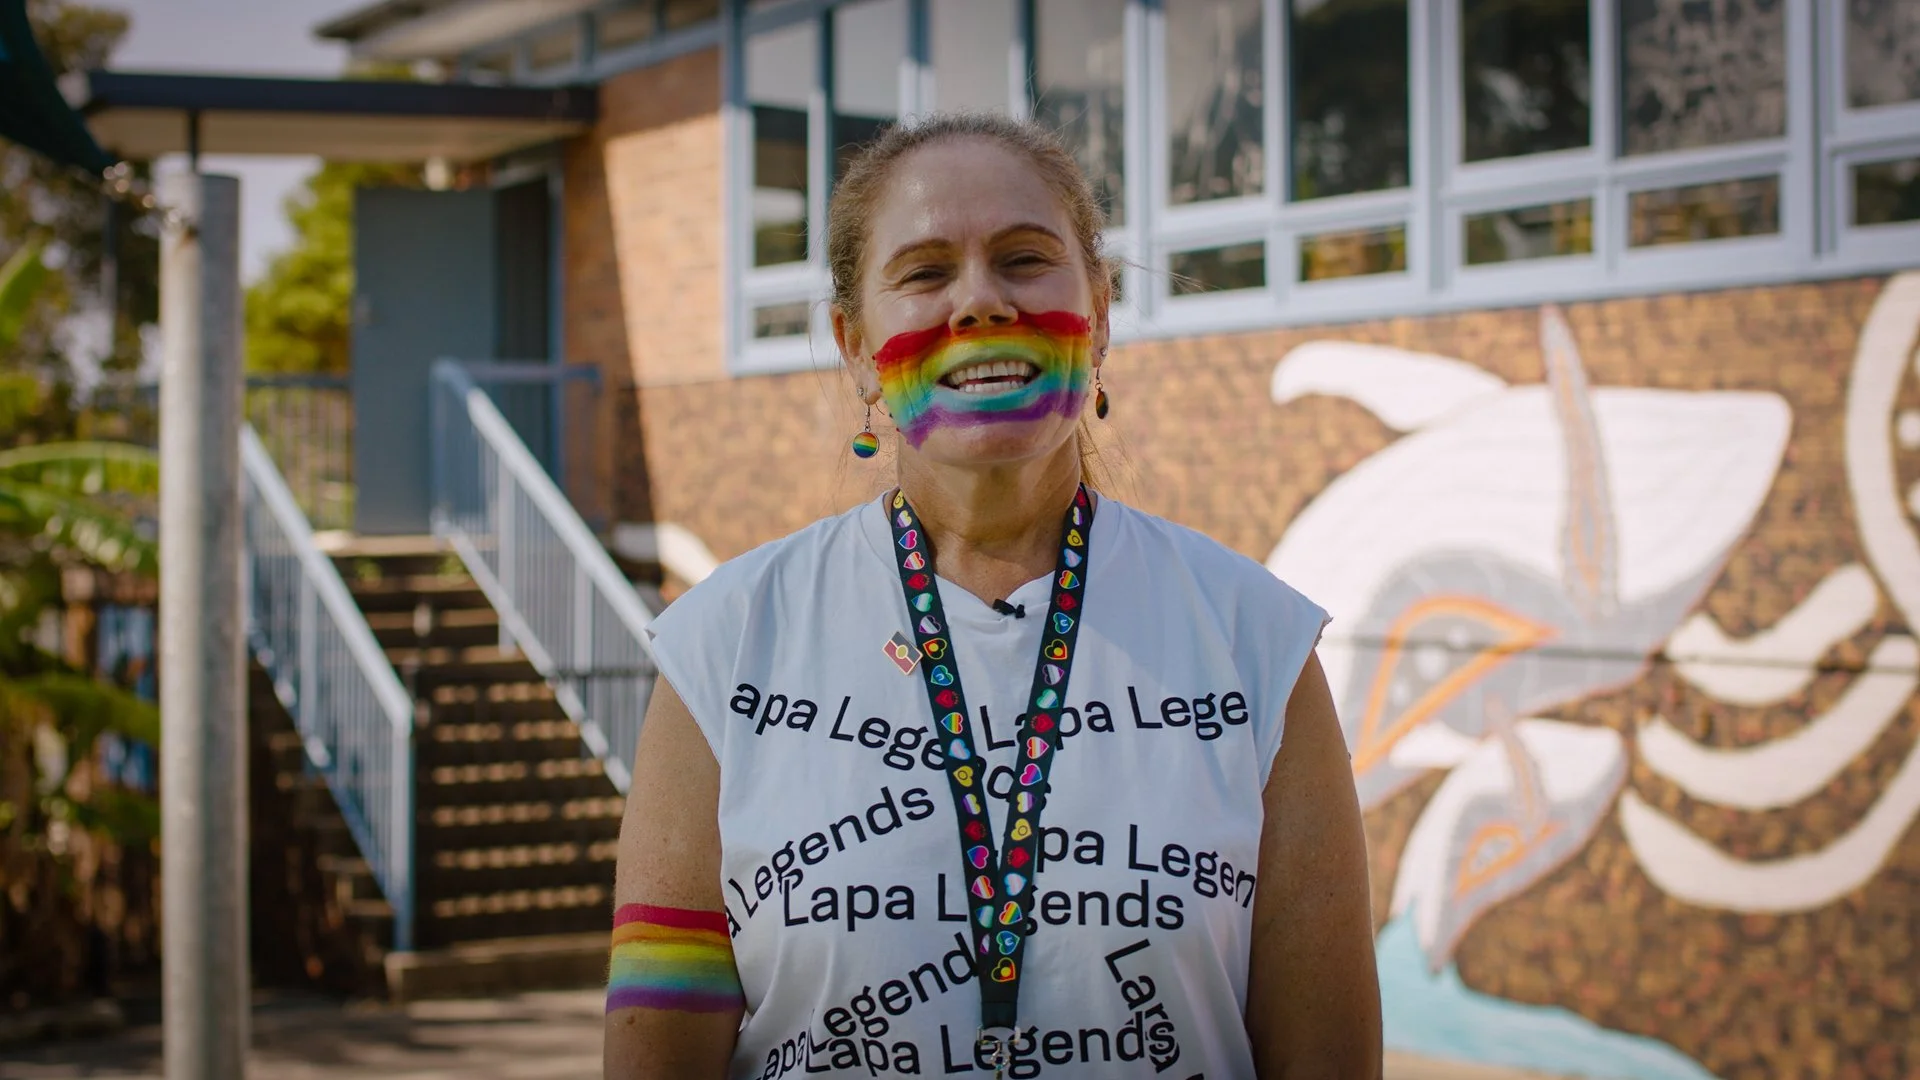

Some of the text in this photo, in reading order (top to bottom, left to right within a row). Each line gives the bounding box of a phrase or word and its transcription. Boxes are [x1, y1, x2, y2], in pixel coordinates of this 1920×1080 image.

[728, 785, 935, 919] Legends
[783, 873, 1184, 936] Lapa Lends
[805, 1011, 1176, 1080] Lapa Legends
